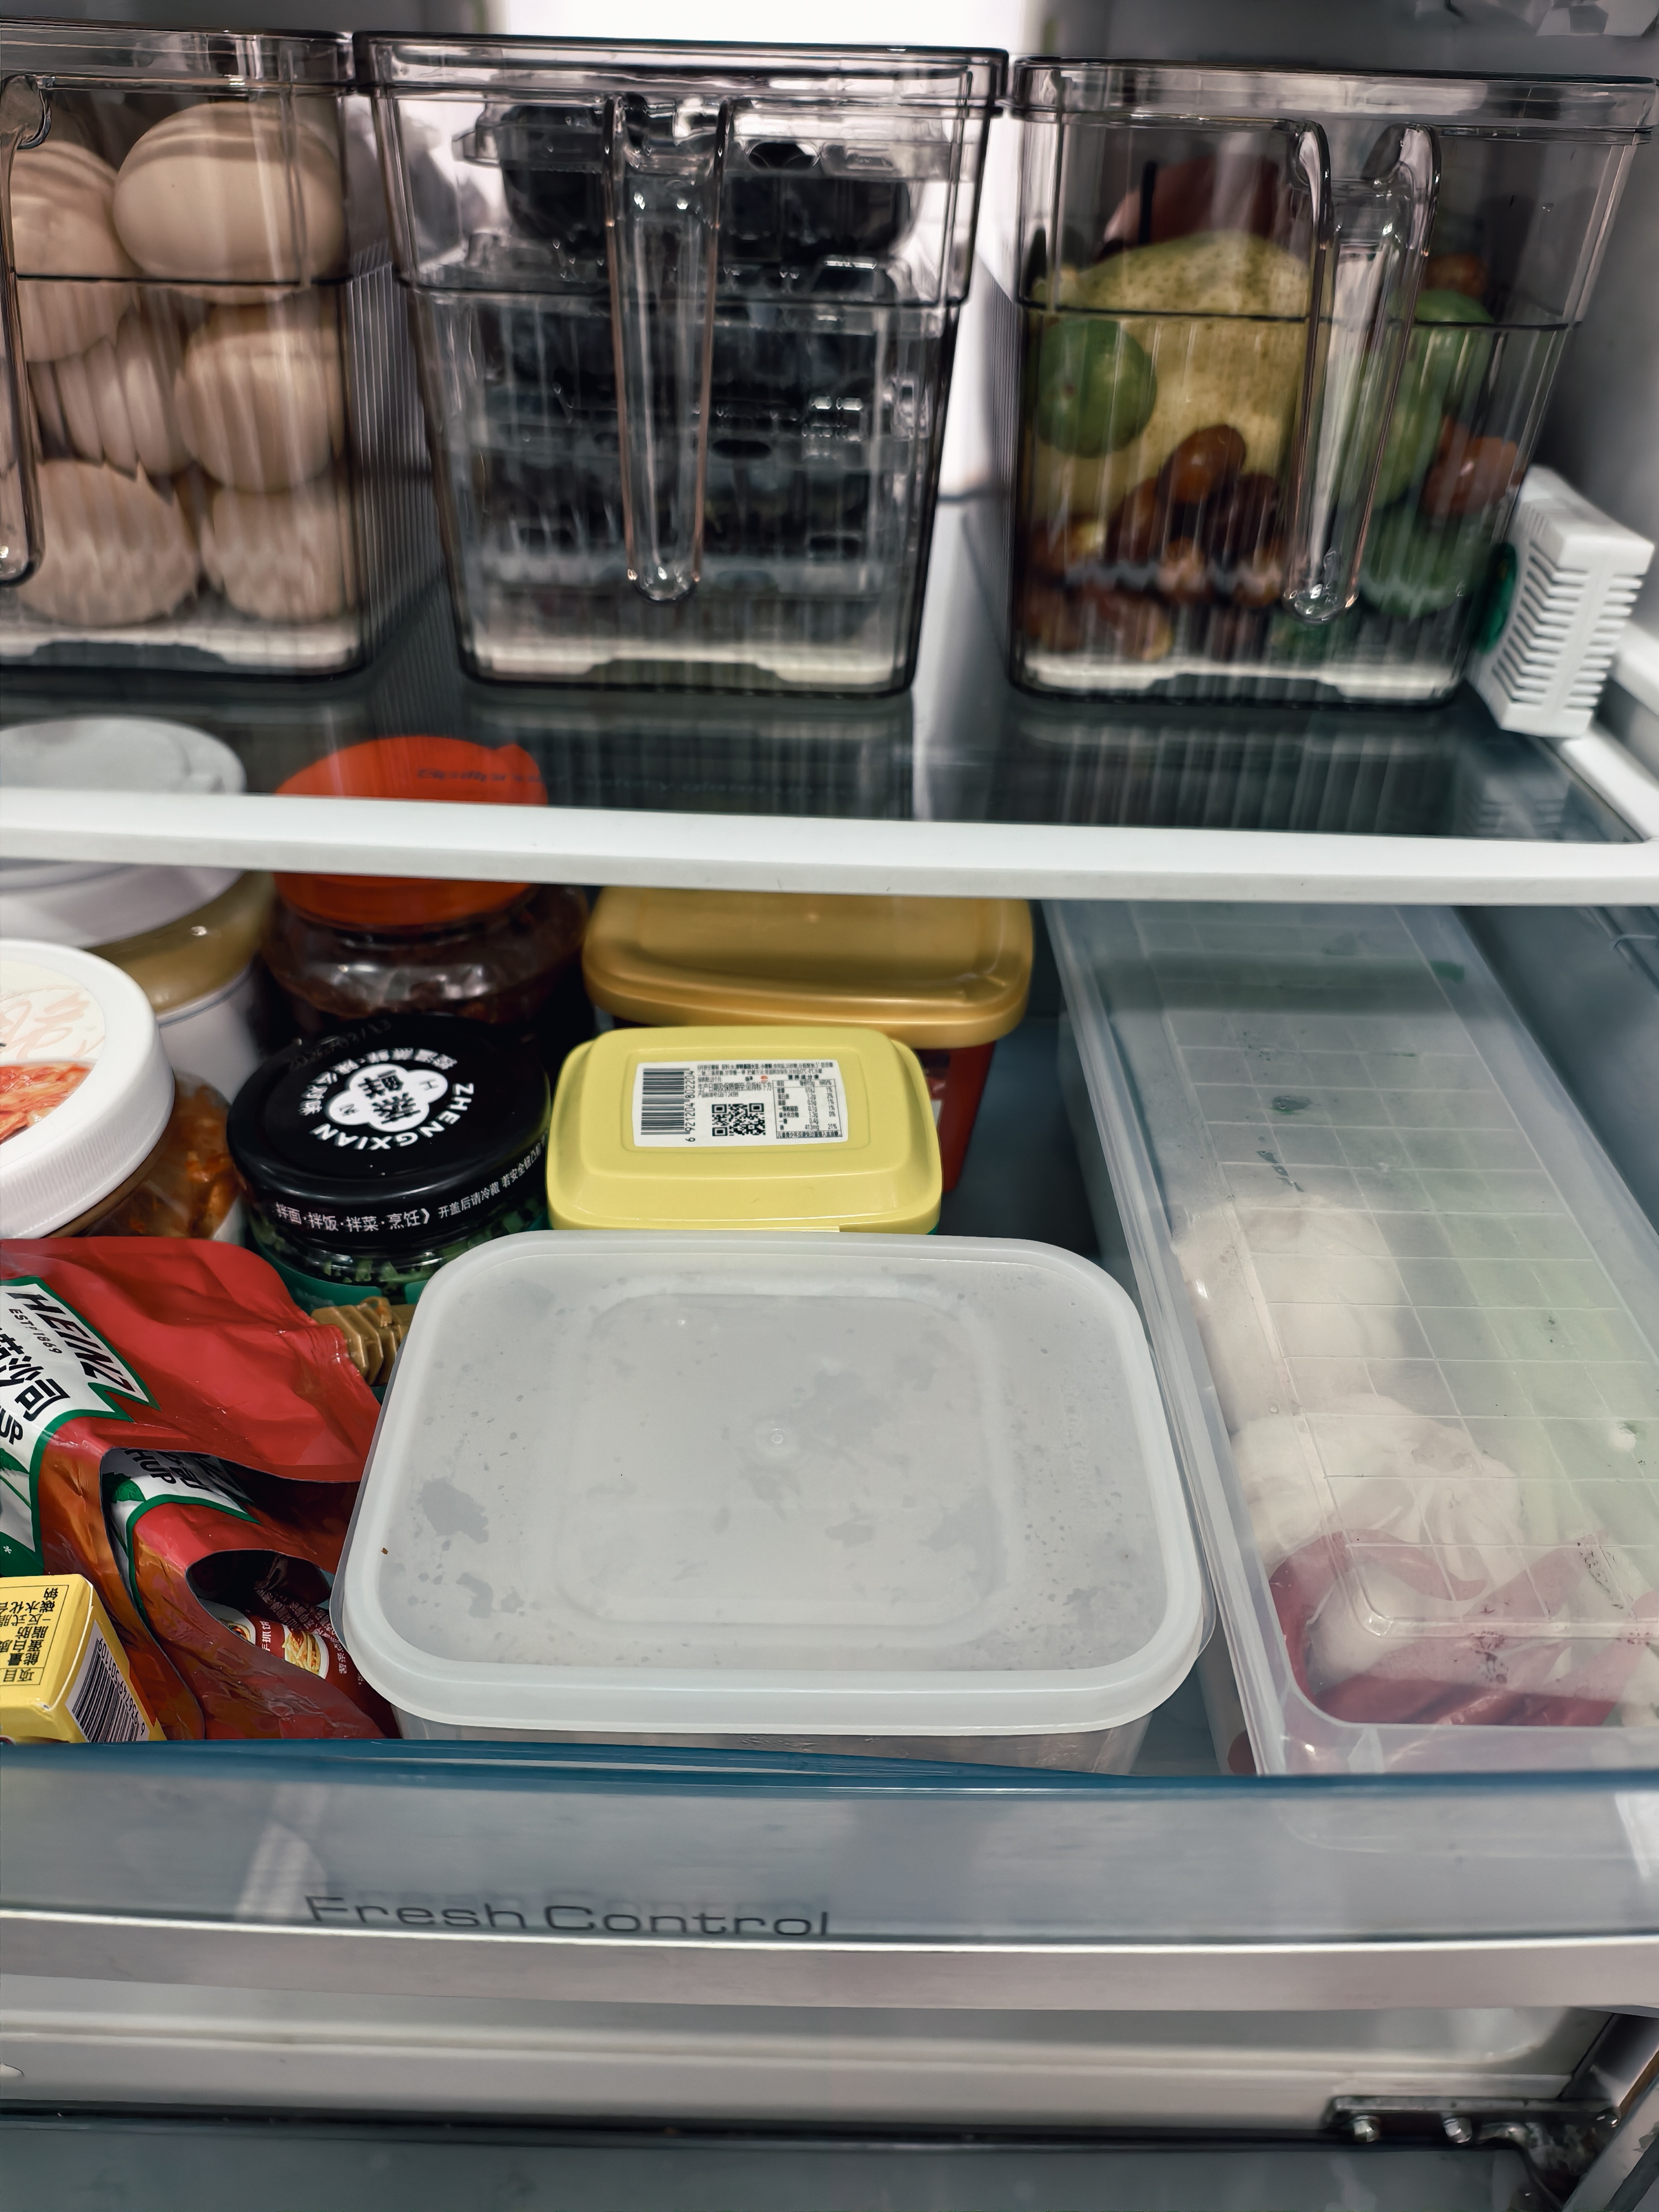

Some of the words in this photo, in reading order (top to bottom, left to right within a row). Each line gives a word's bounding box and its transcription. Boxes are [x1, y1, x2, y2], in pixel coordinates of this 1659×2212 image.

[309, 1082, 475, 1151] ZHENGXIAN
[6, 1291, 136, 1392] HEINZ
[33, 1333, 63, 1354] 1869
[121, 1448, 177, 1485] HUP
[43, 1588, 58, 1600] 钠
[15, 1626, 49, 1639] 脂肪
[8, 1652, 40, 1666] 能量
[3, 1668, 35, 1682] 项目
[305, 1895, 527, 1930] Fresh
[544, 1904, 828, 1936] Control
